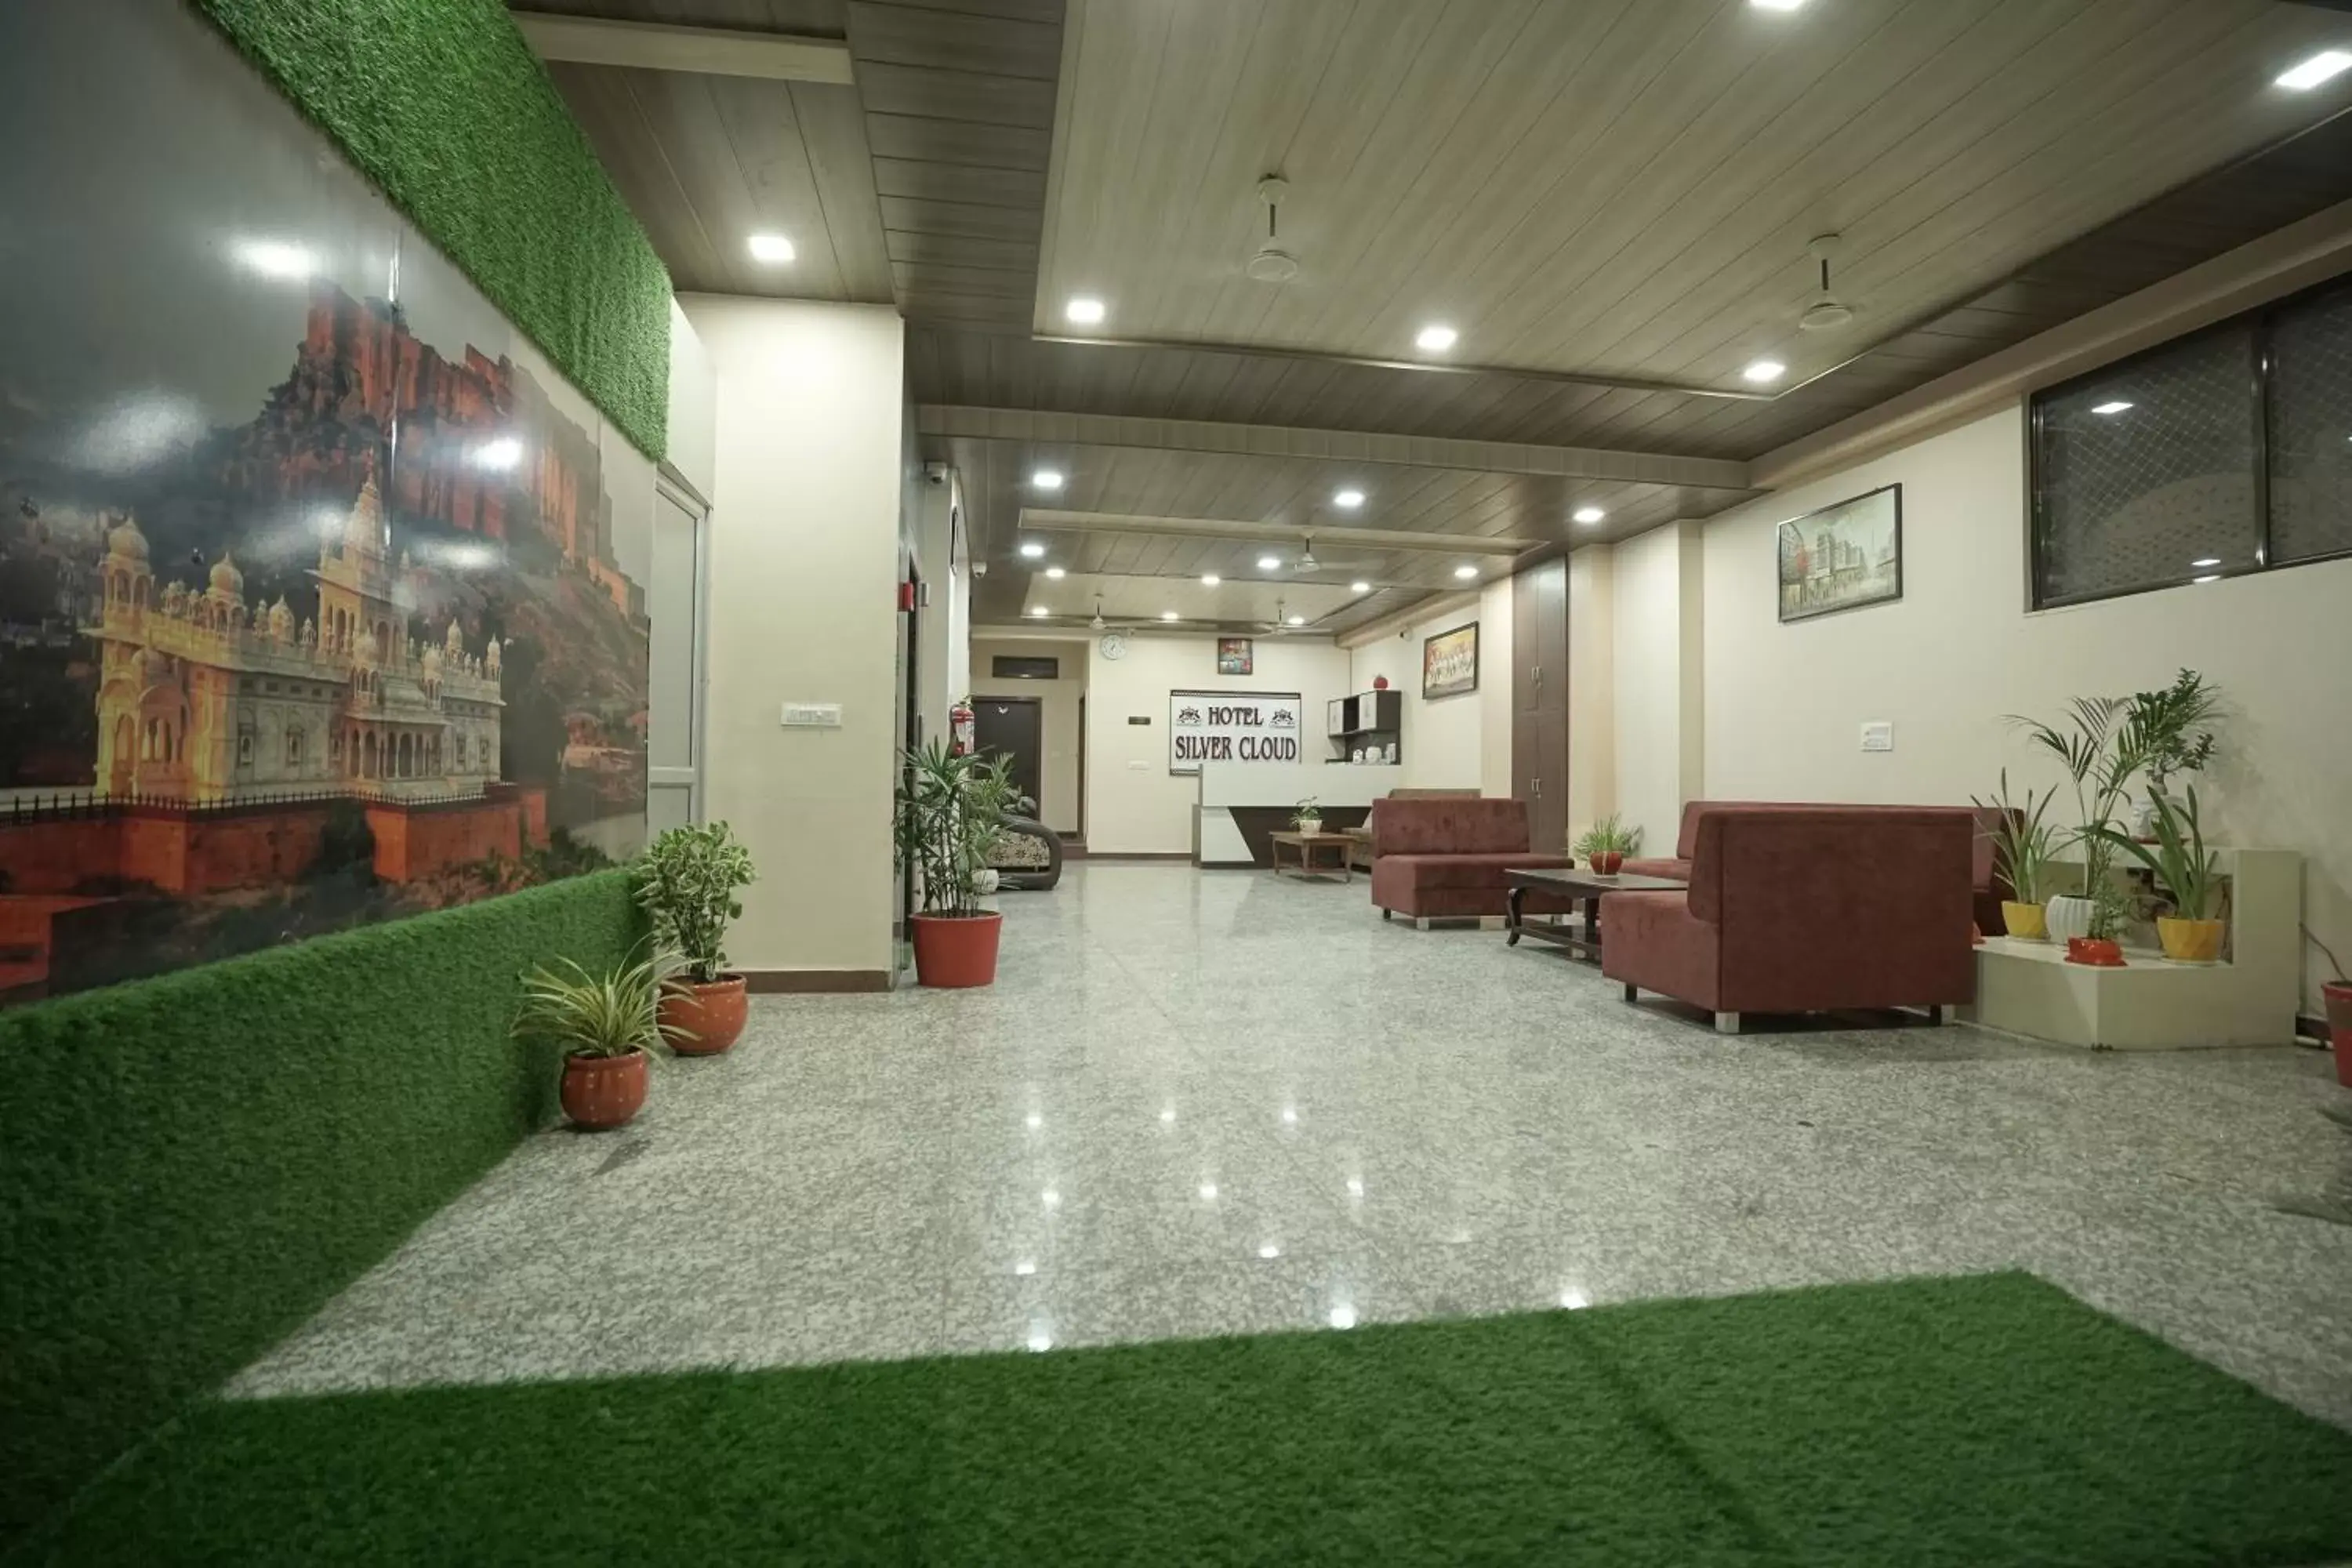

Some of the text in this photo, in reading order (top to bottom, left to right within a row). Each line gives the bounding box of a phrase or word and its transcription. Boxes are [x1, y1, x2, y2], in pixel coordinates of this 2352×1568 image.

[1208, 706, 1264, 725] HOTEL
[1175, 735, 1296, 760] SILVER CLOUD
